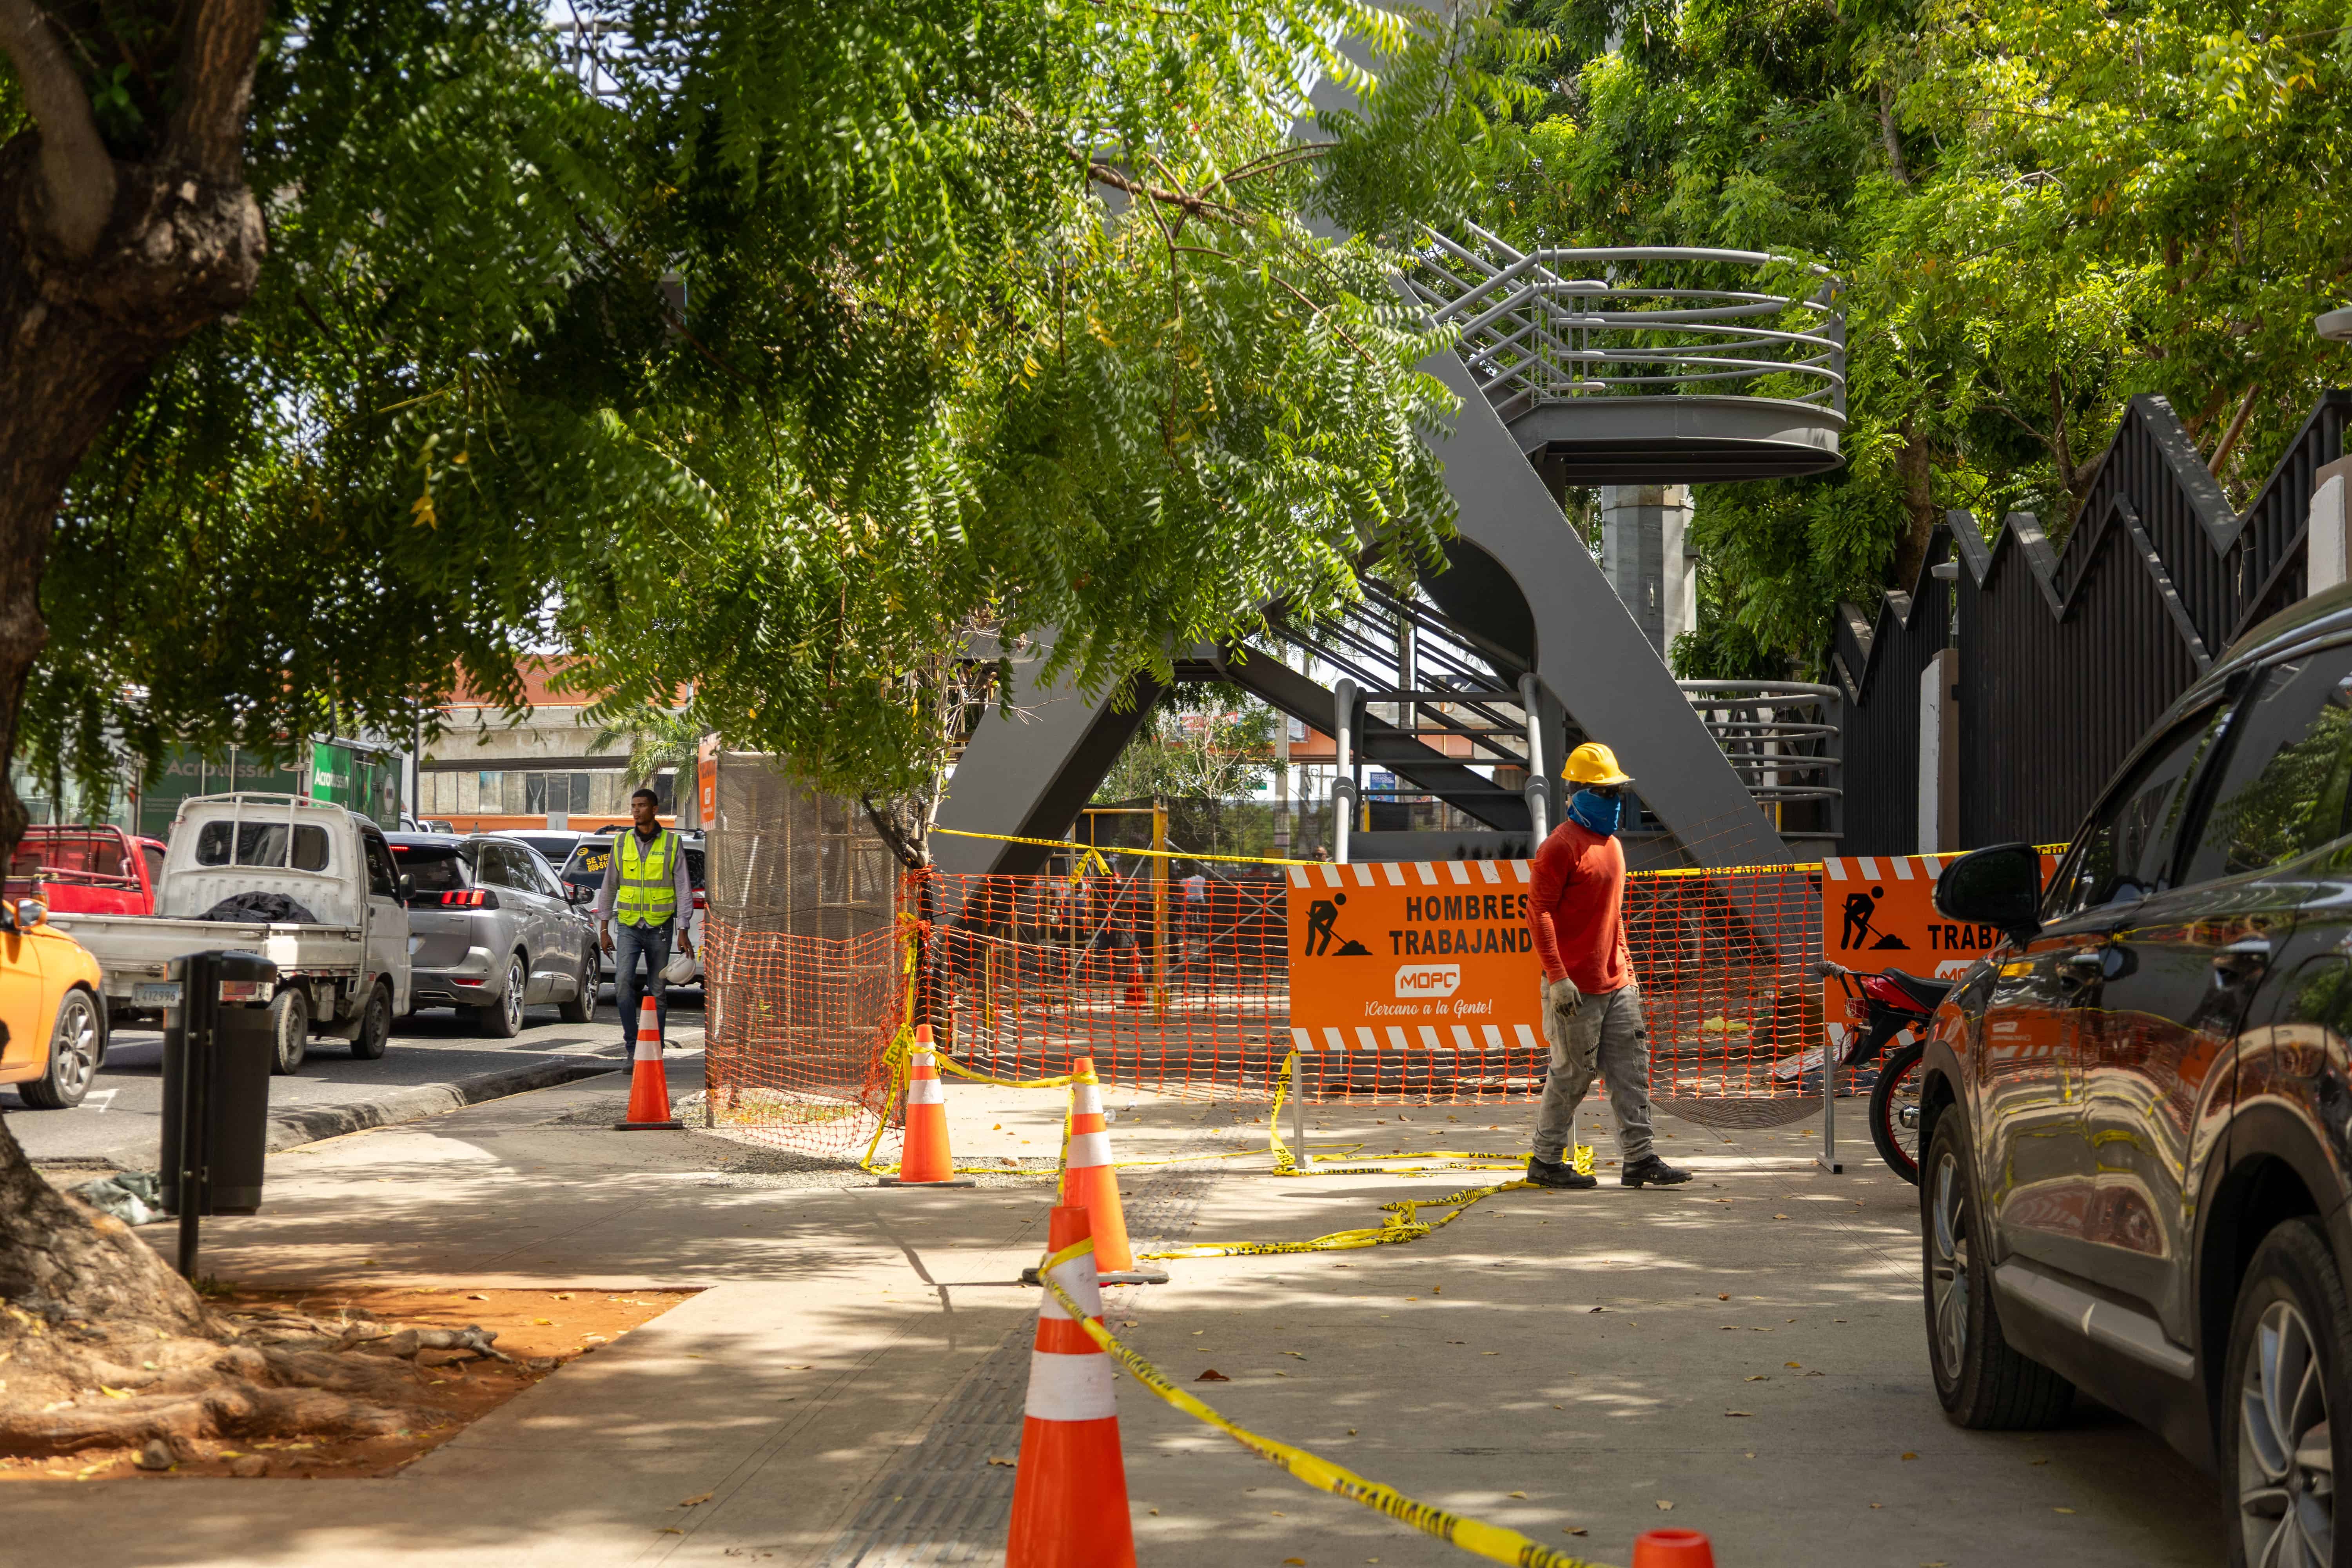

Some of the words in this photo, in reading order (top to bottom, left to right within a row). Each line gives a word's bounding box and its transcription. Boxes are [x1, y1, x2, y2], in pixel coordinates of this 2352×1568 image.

[586, 857, 597, 865] SE
[1406, 893, 1528, 922] HOMBRES
[1389, 927, 1533, 955] TRABAJAND
[1400, 972, 1457, 989] MOPC
[1365, 1001, 1419, 1016] ¡Cercano
[1423, 1004, 1433, 1015] a
[1436, 1000, 1449, 1015] la
[1454, 999, 1492, 1019] Gente!
